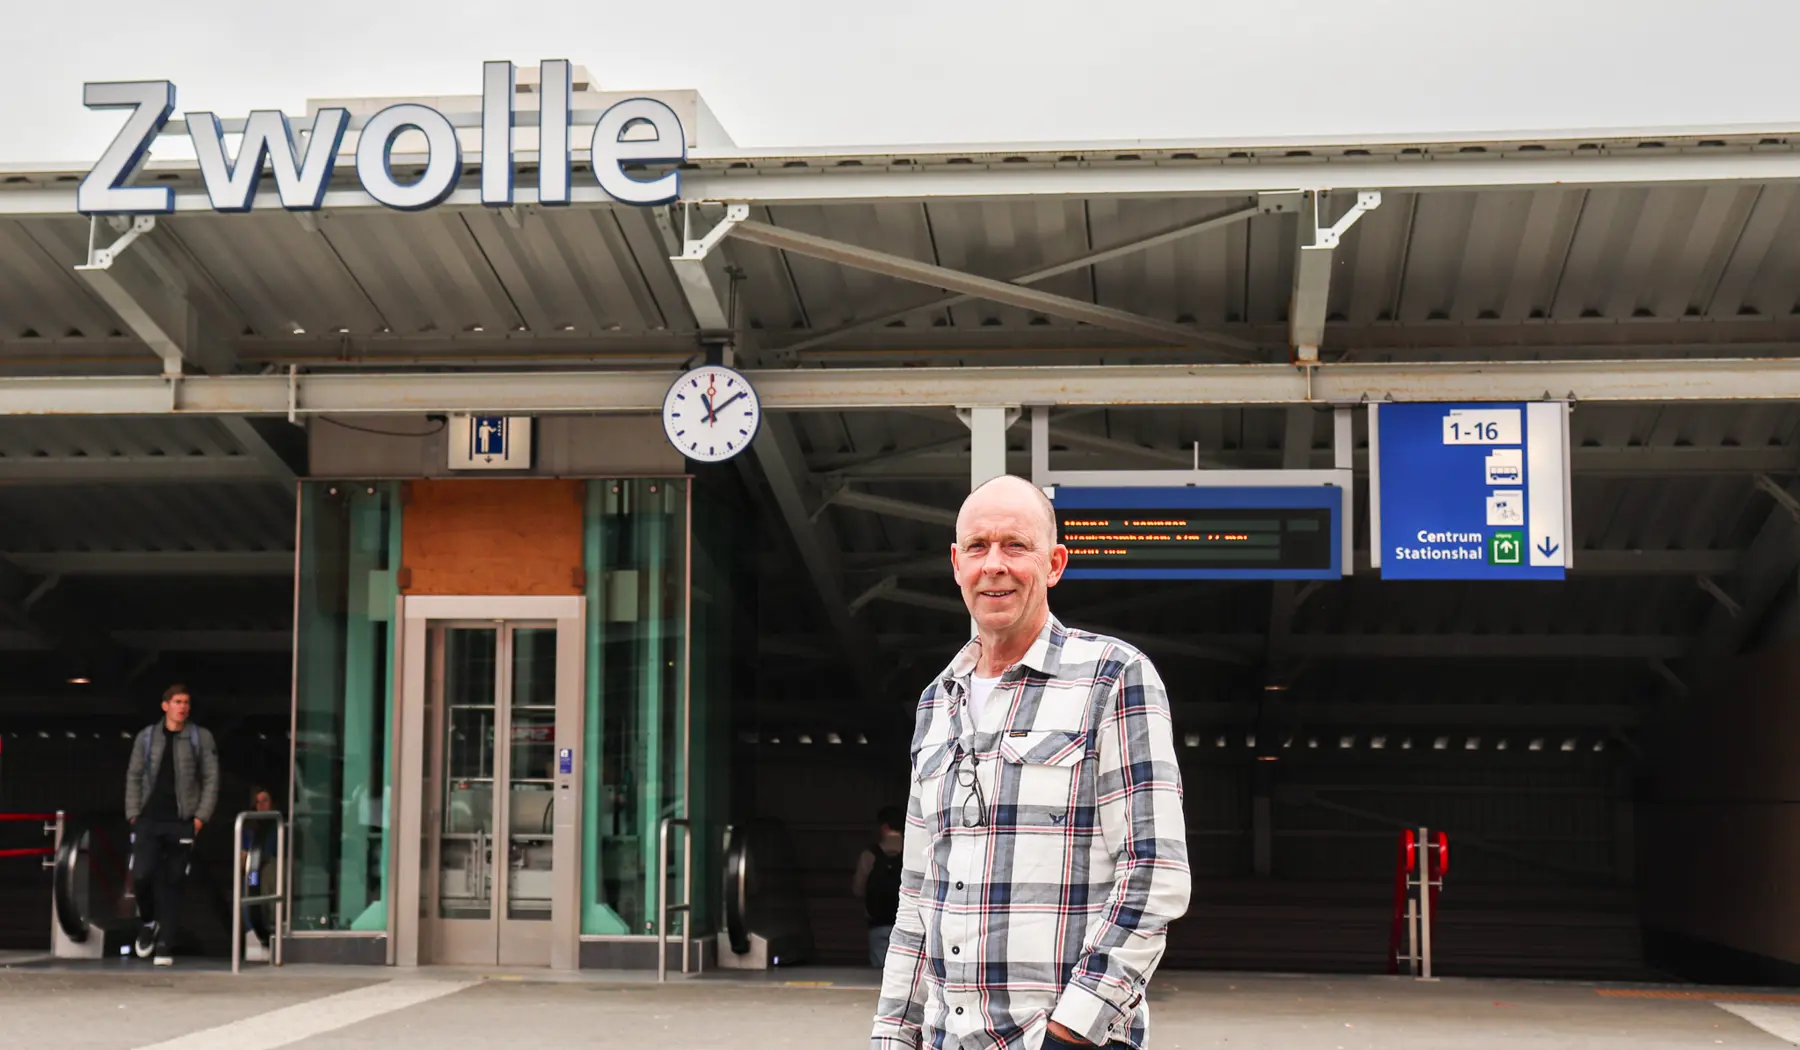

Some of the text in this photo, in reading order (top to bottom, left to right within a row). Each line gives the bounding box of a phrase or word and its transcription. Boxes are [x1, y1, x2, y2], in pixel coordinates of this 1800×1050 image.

[77, 58, 688, 214] Zwolle
[1417, 530, 1482, 543] Centrum
[1395, 547, 1482, 560] Stationshal
